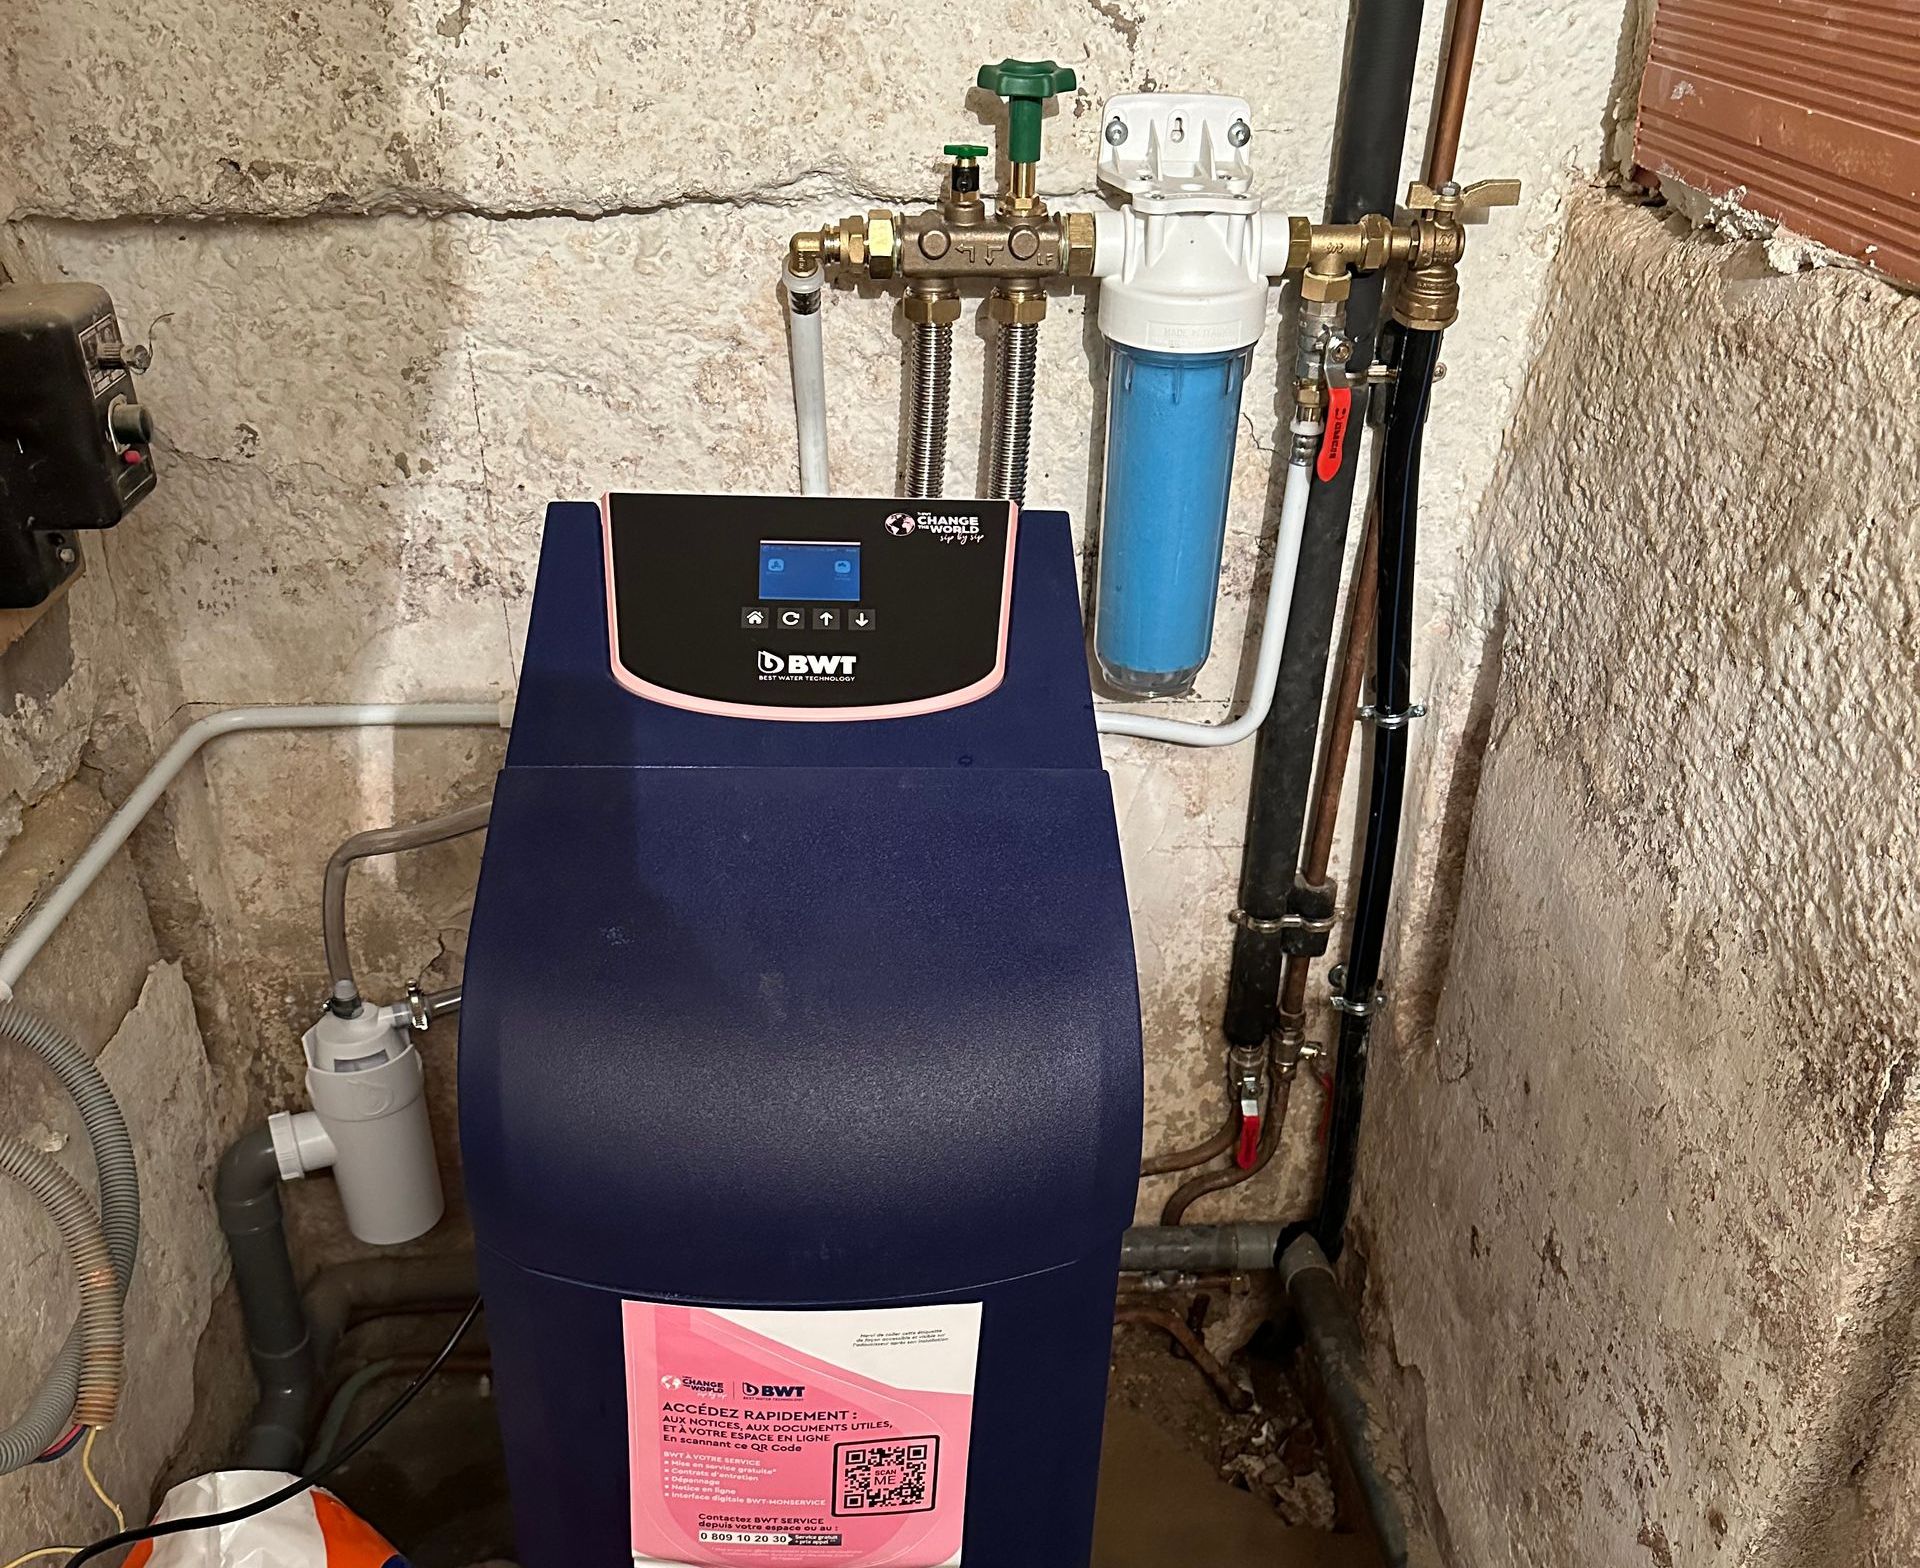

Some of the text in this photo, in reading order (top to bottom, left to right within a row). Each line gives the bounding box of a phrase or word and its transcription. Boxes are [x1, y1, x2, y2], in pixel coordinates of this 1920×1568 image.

[917, 516, 979, 526] CHANGE
[930, 525, 980, 534] WORLD
[940, 531, 985, 545] sip by sip
[788, 655, 857, 675] BWT
[682, 1378, 724, 1389] CHANGE
[691, 1385, 724, 1394] WORLD
[762, 1386, 806, 1397] BWT
[662, 1402, 739, 1419] ACCÉDEZ
[744, 1410, 850, 1421] RAPIDEMENT
[662, 1415, 893, 1432] AUX NOTICES, AUX DOCUMENTS UTILES,
[663, 1425, 677, 1433] ET
[679, 1424, 687, 1434] À
[689, 1427, 728, 1438] VOTRE
[731, 1432, 774, 1441] ESPACE
[680, 1437, 731, 1448] scannant
[751, 1443, 769, 1452] QR
[771, 1444, 802, 1452] Code
[663, 1451, 684, 1459] BWT
[693, 1454, 722, 1463] VOTRE
[724, 1457, 761, 1466] SERVICE
[671, 1468, 709, 1477] Contrats
[705, 1463, 736, 1472] service
[874, 1476, 896, 1485] ME
[671, 1484, 700, 1492] Notice
[715, 1486, 736, 1495] ligne
[671, 1492, 711, 1501] Interface
[711, 1494, 745, 1504] digitale
[698, 1513, 752, 1523] Contactez
[698, 1521, 733, 1529] depuis
[700, 1532, 787, 1543] 0 809 10 20 30
